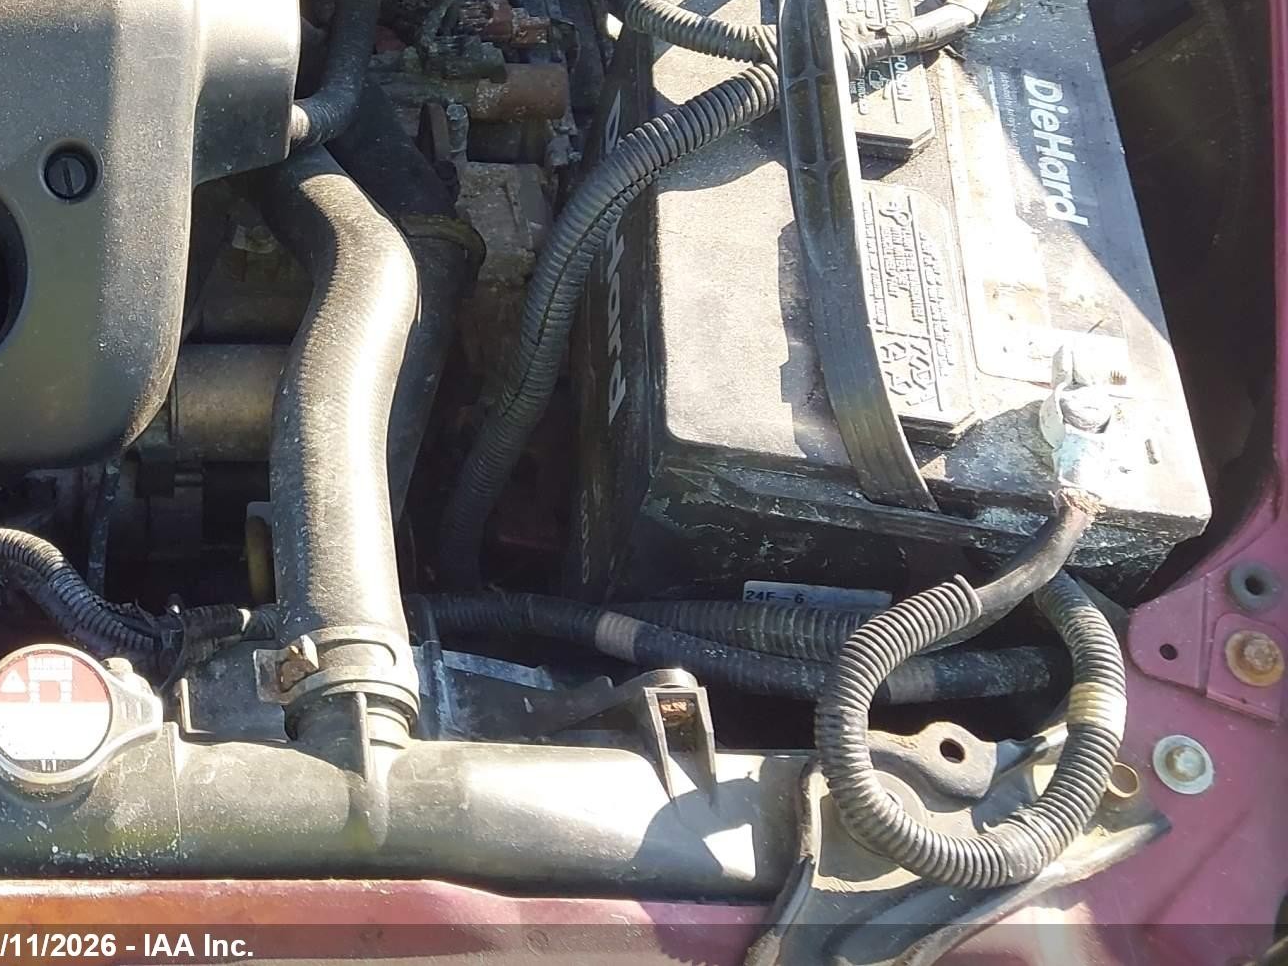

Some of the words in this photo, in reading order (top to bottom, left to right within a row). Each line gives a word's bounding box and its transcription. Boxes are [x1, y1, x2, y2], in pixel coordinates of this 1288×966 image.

[893, 54, 913, 101] POISON
[1024, 75, 1090, 228] DieHard
[605, 90, 628, 425] DHard
